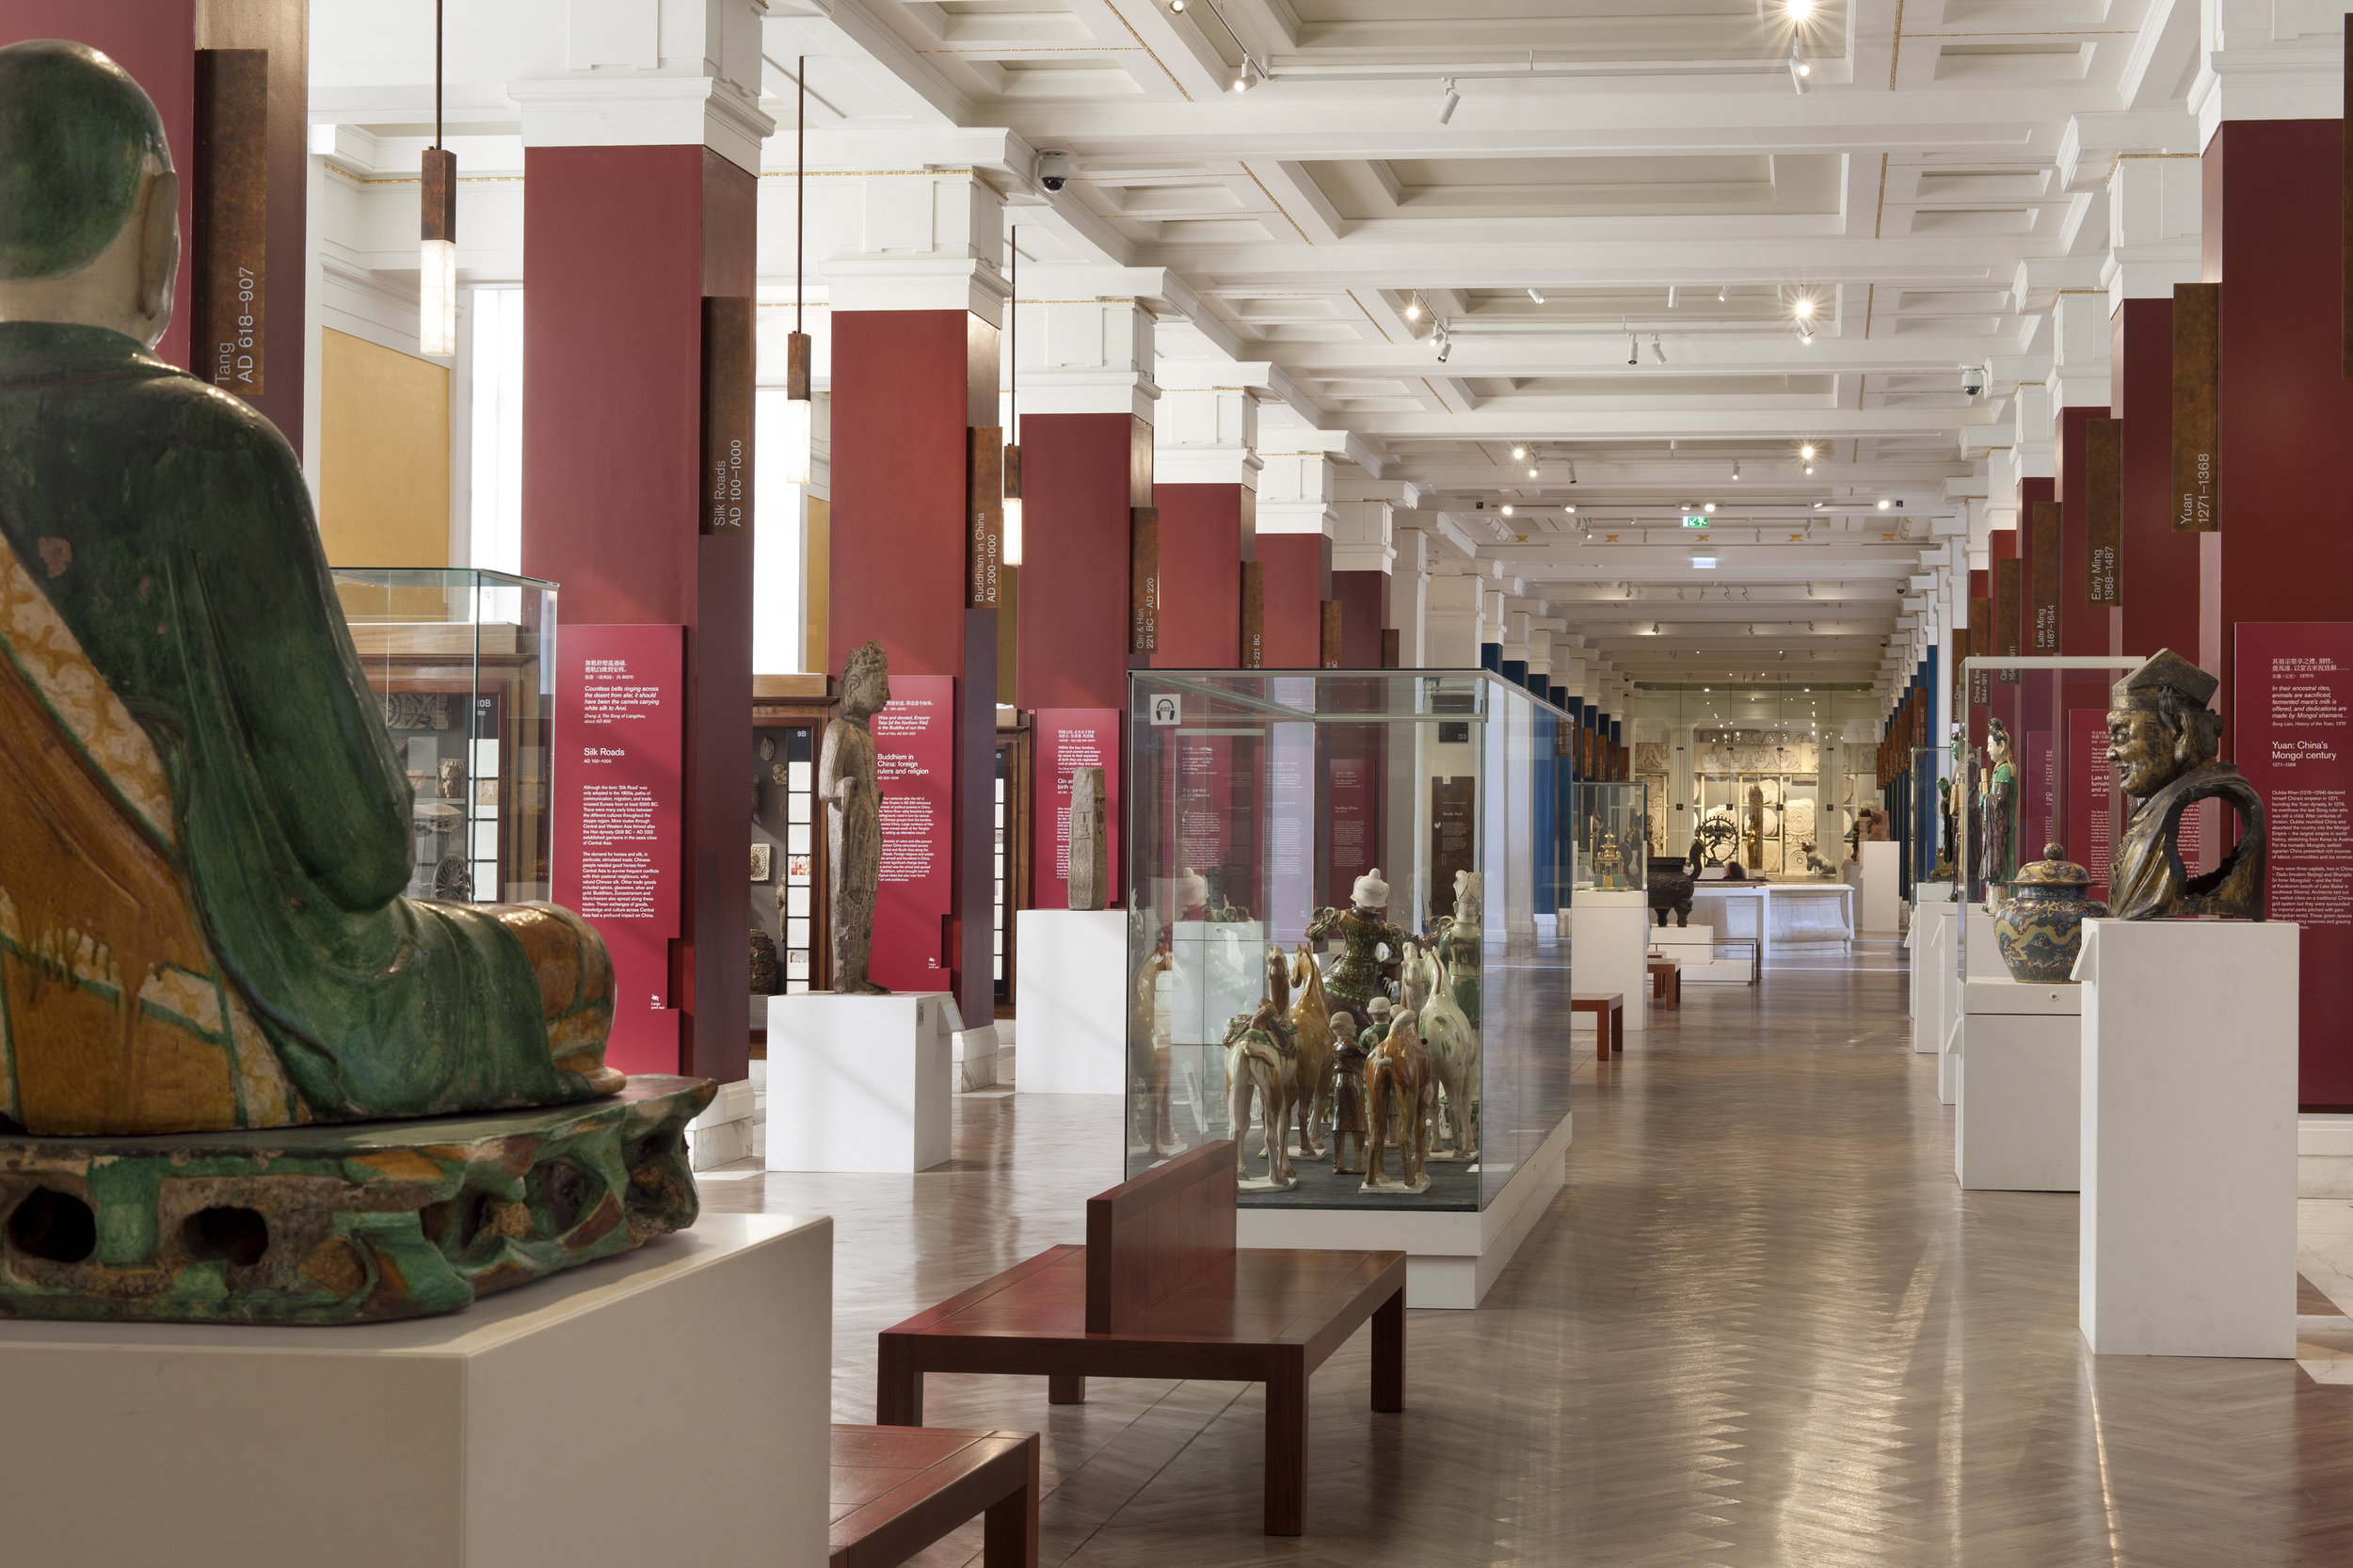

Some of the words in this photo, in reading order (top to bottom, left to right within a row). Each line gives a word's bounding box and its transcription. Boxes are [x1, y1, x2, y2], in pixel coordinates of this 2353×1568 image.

[238, 267, 254, 348] 618–907
[215, 343, 235, 385] Tang
[237, 355, 253, 383] AD
[713, 460, 726, 500] Roads
[729, 440, 742, 502] 100–1000
[2198, 453, 2210, 523] 1271–1368
[713, 504, 726, 526] Silk
[729, 507, 742, 527] AD
[2180, 492, 2193, 525] Yuan
[975, 512, 985, 540] China
[986, 534, 997, 584] 200–1000
[2091, 549, 2105, 573] Ming
[974, 554, 984, 602] Buddhism
[2105, 546, 2114, 600] 1368–1487
[986, 587, 996, 602] AD
[2091, 576, 2105, 600] Early
[1145, 595, 1154, 609] AD
[1146, 617, 1154, 632] BC
[2037, 608, 2047, 629] Ming
[1136, 634, 1144, 649] Qin
[1253, 633, 1260, 646] BC
[2037, 630, 2045, 648] Late
[2272, 751, 2303, 760] Mongol
[2305, 751, 2336, 760] century
